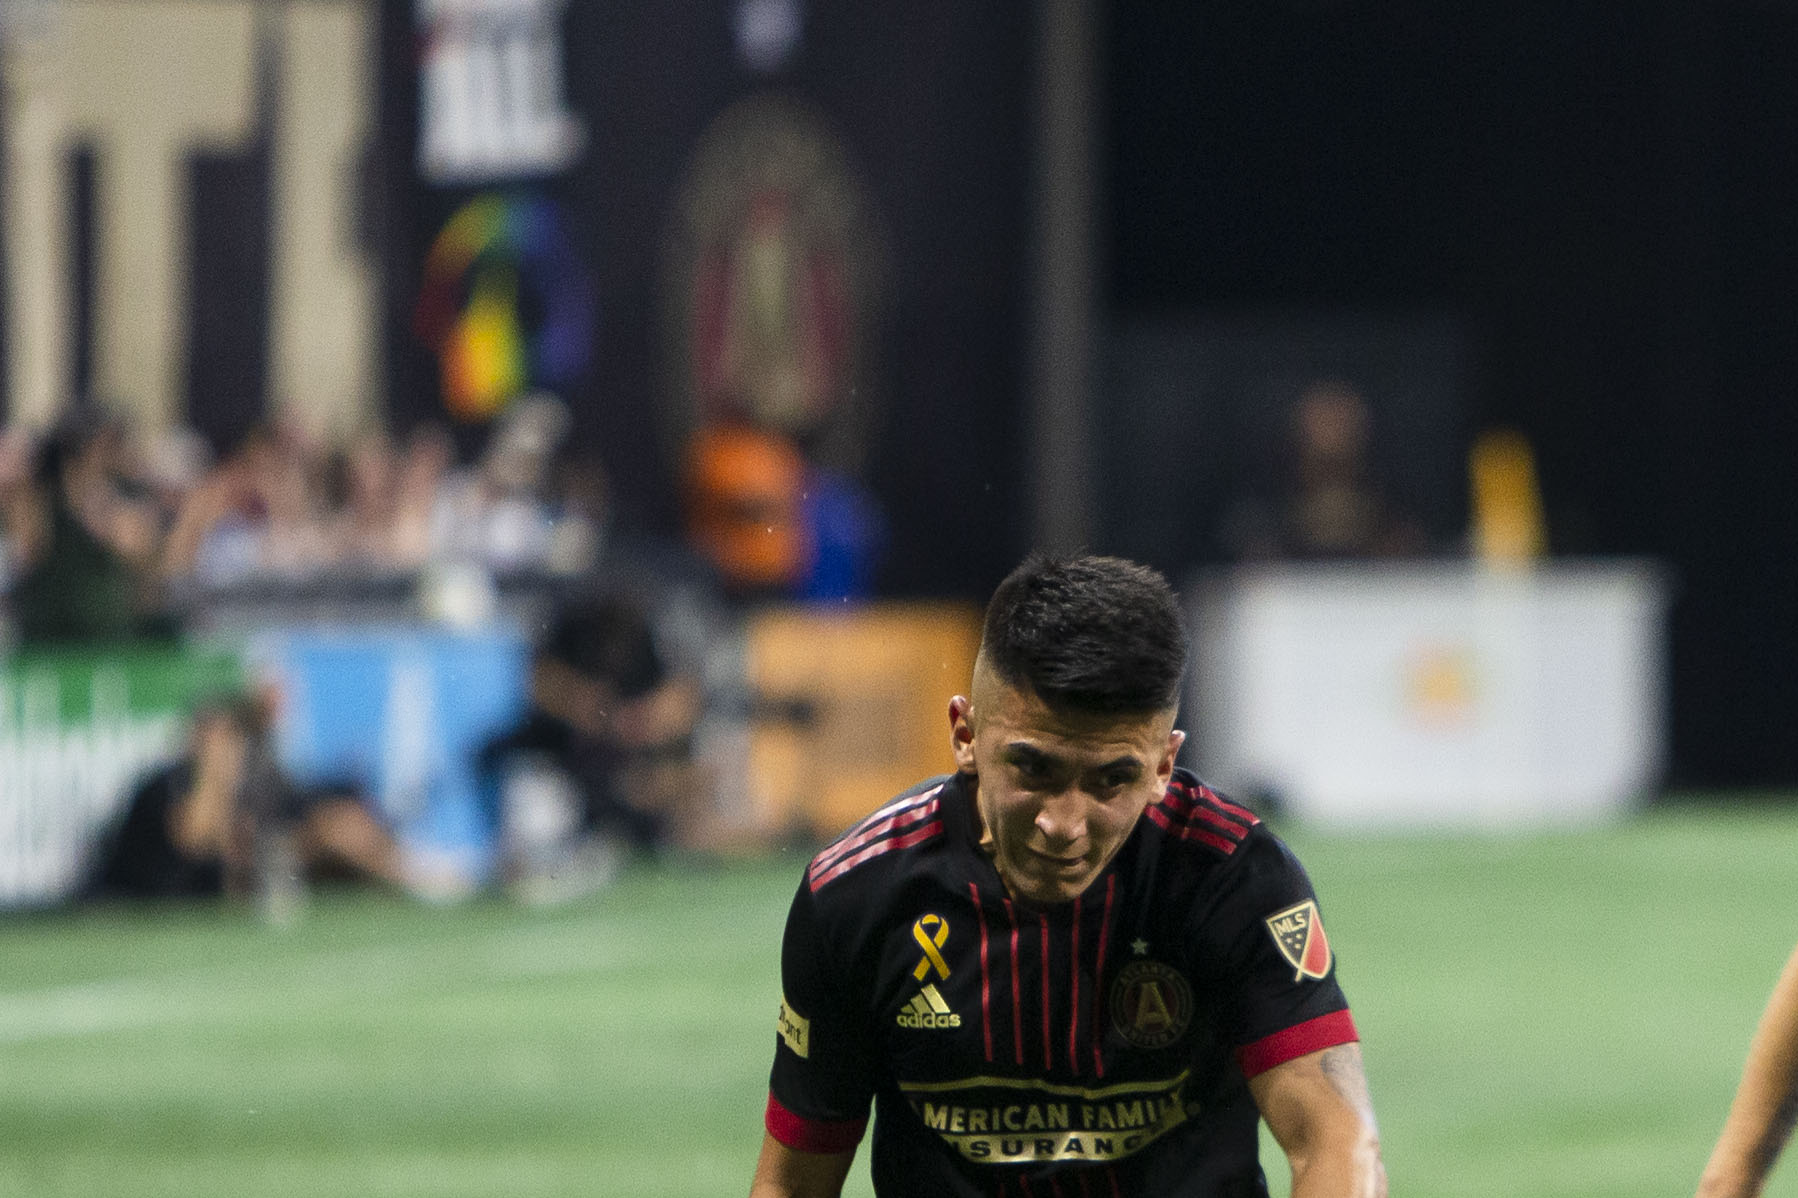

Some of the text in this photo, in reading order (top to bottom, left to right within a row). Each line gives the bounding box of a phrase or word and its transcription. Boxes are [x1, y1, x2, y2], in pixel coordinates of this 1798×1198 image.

[1274, 912, 1306, 936] MLS
[896, 1011, 961, 1028] adidas
[923, 1100, 1070, 1132] MERICAN
[952, 1135, 1146, 1158] SURANC
